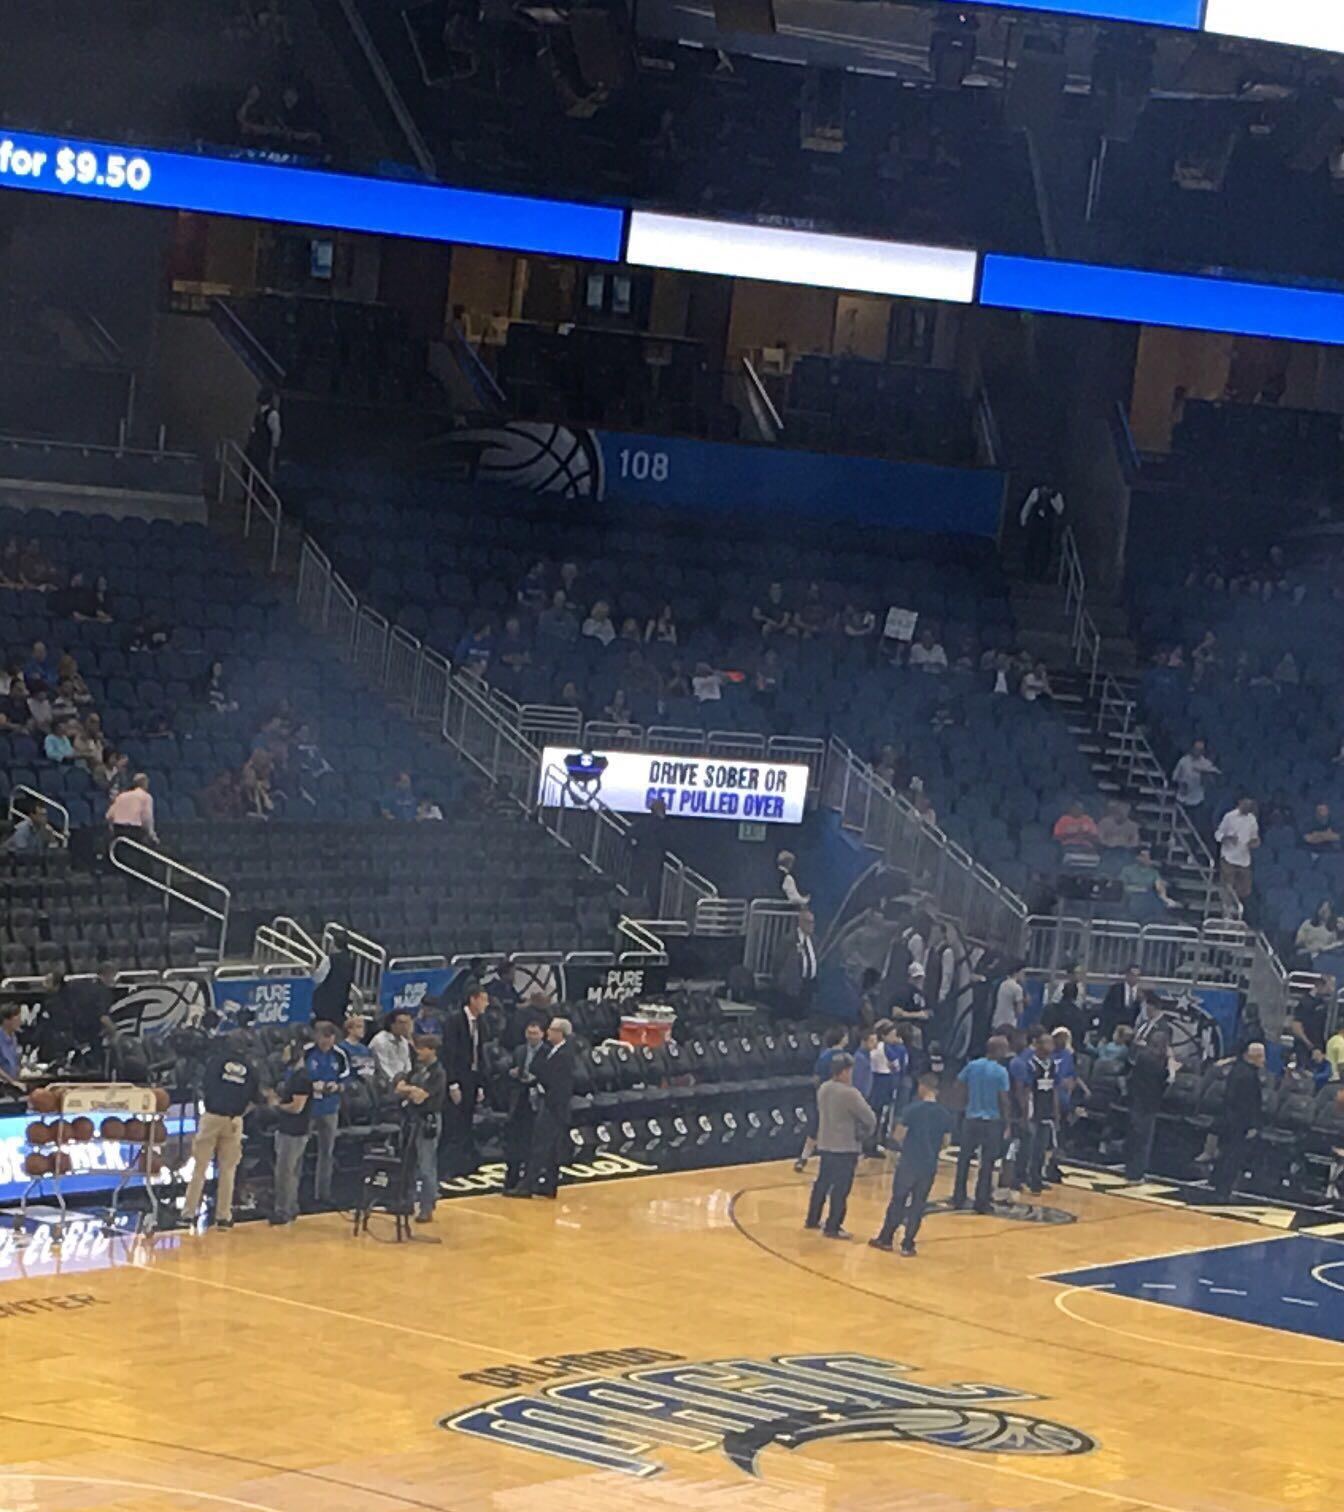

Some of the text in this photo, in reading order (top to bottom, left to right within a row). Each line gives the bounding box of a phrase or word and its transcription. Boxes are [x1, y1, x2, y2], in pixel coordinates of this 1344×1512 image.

[55, 146, 151, 191] $9.50
[620, 450, 669, 481] 108
[649, 761, 787, 793] DRIVE SOBER OR
[680, 791, 738, 815] PULLED
[743, 794, 784, 819] OVER
[459, 1347, 688, 1390] ORLANDO
[438, 1352, 1051, 1478] MAGIC
